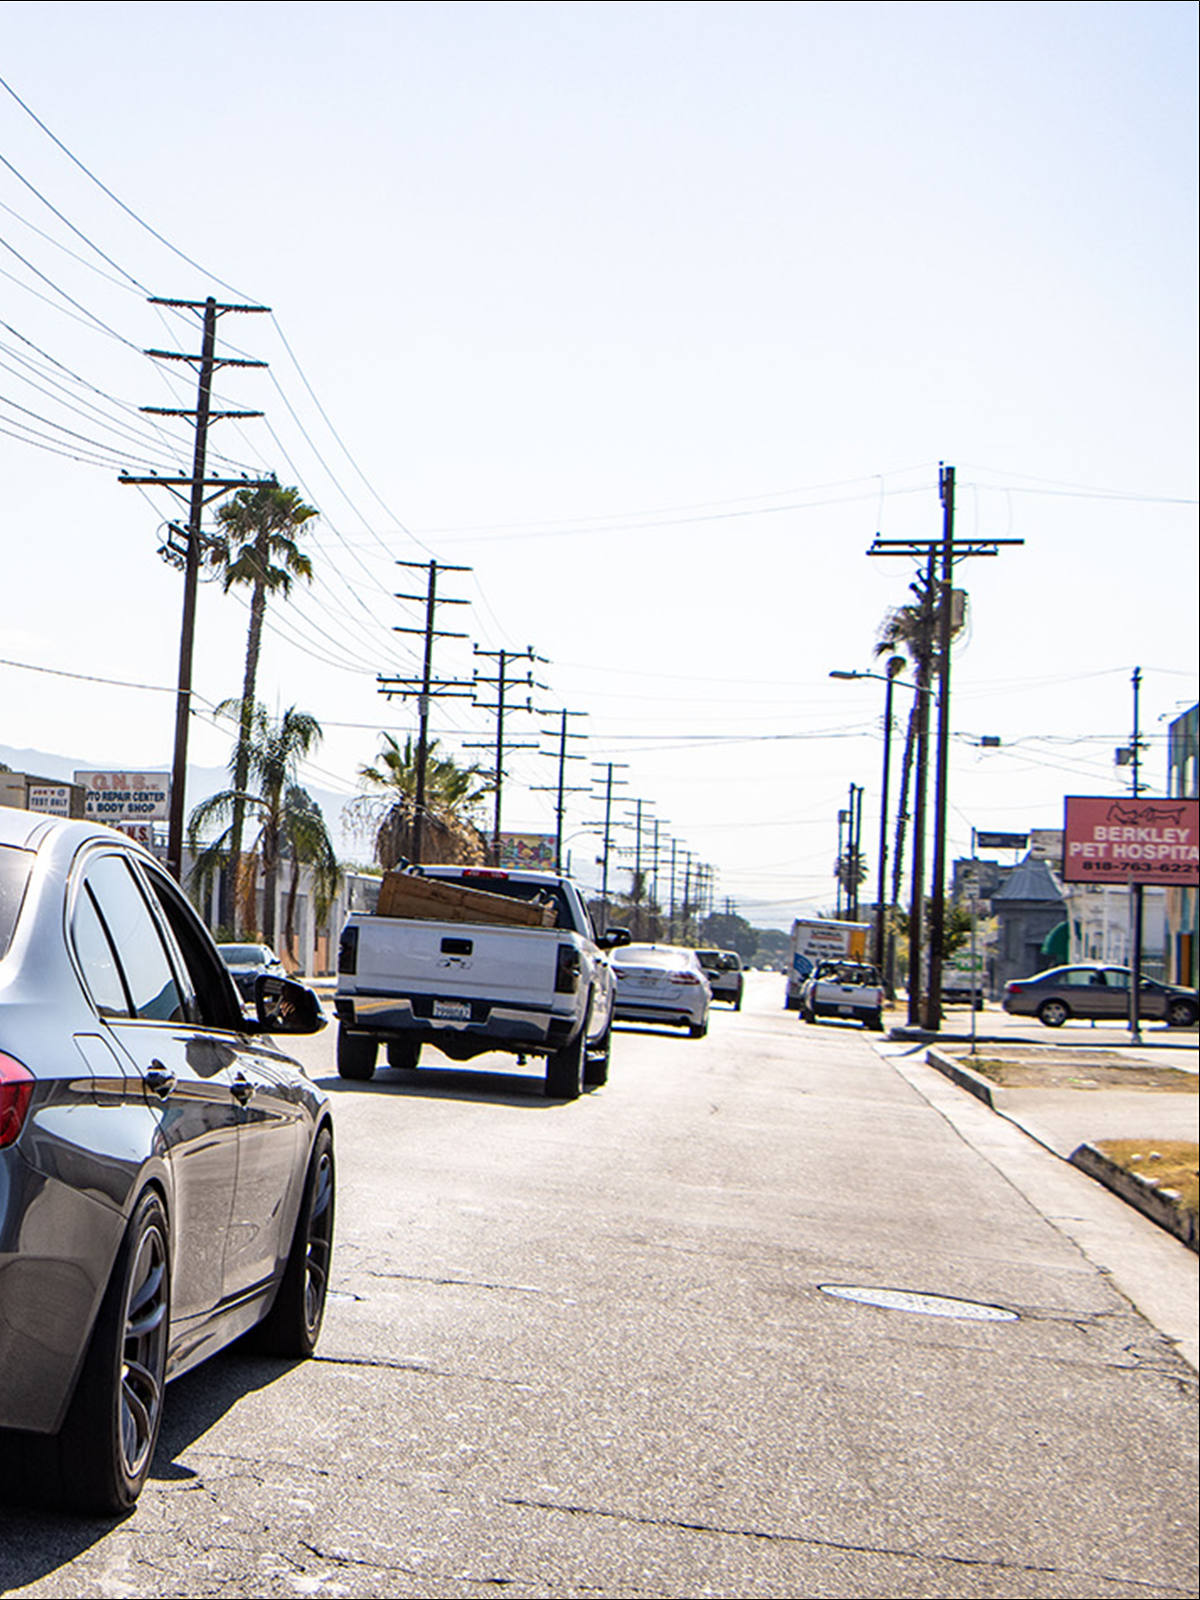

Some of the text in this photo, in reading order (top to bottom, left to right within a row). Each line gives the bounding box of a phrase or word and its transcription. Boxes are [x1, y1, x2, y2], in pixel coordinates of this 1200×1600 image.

[102, 791, 131, 802] REPAIR
[133, 791, 165, 803] CENTER
[86, 802, 156, 813] & BODY SHOP
[1093, 825, 1191, 844] BERKLEY
[1068, 842, 1199, 861] PET HOSPITA
